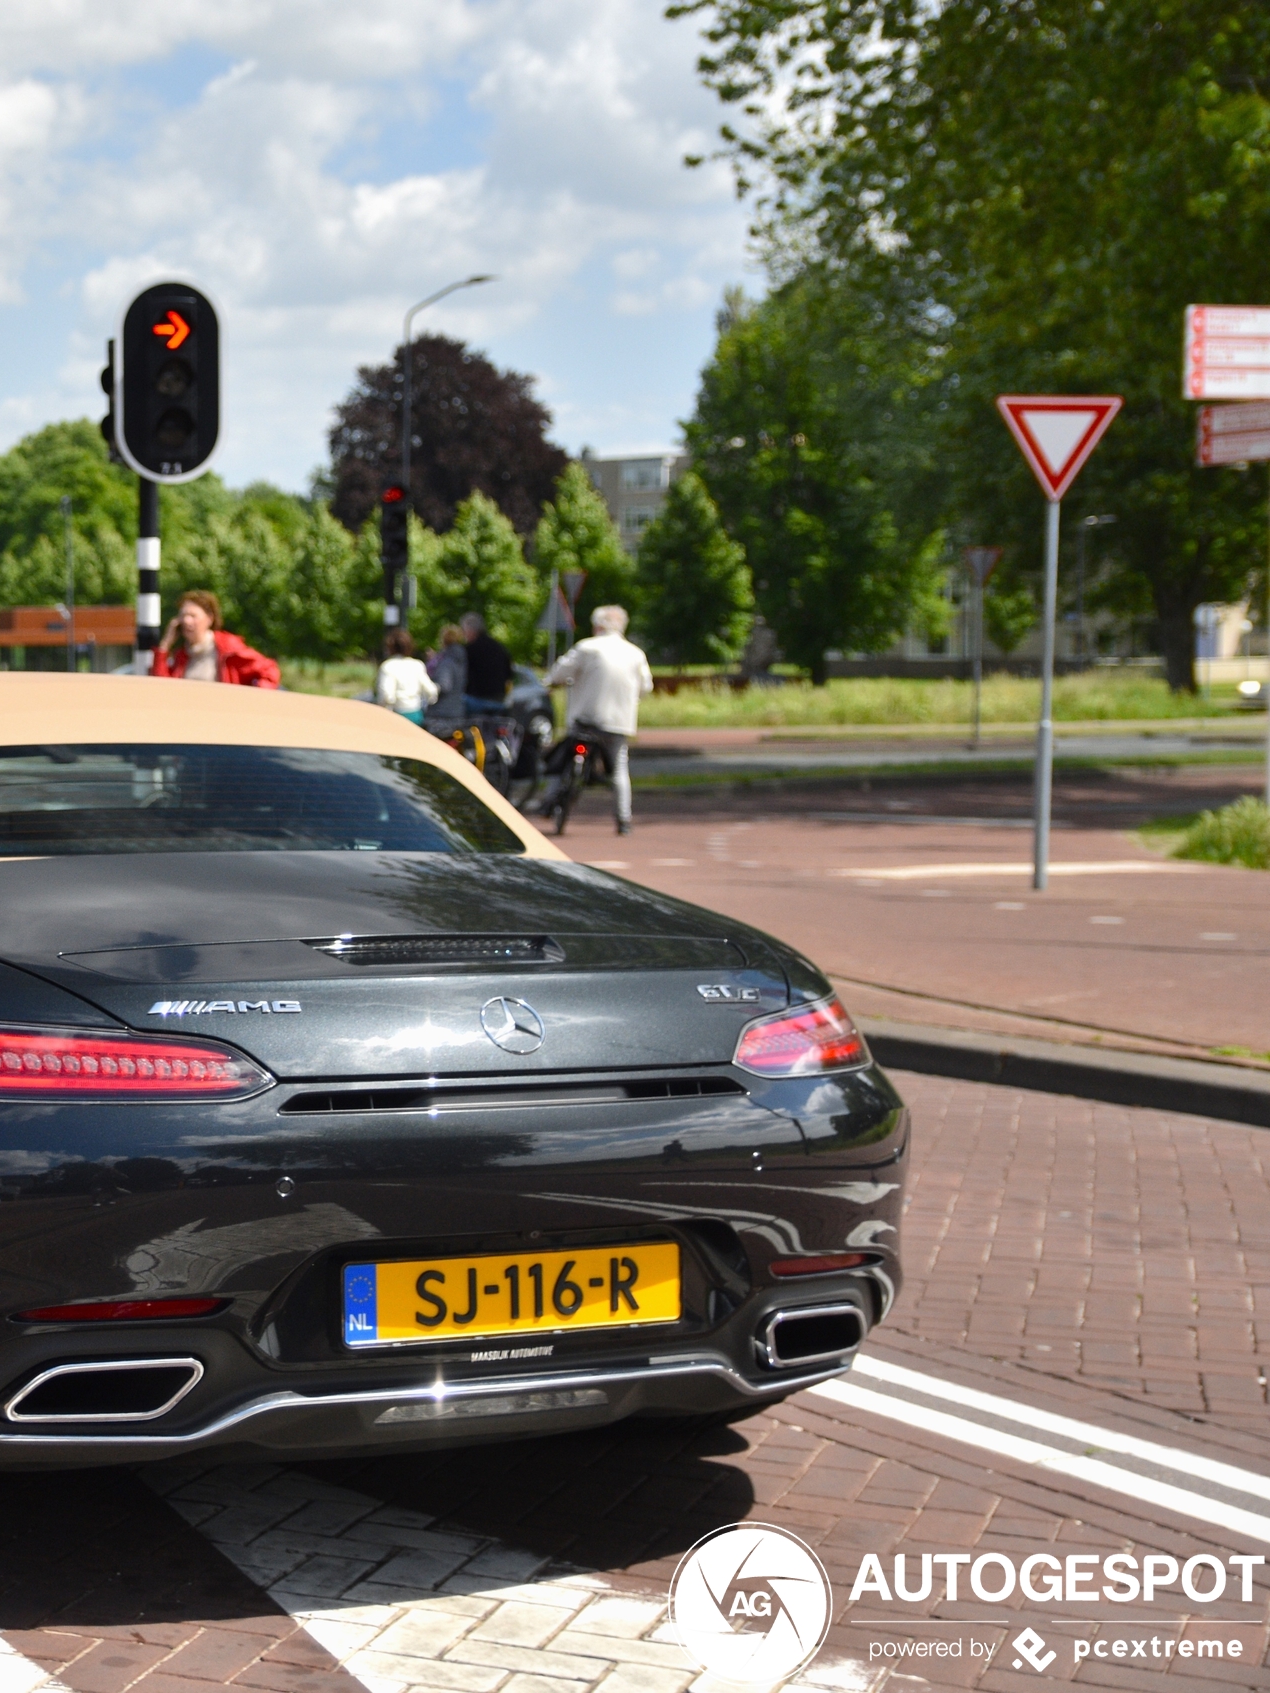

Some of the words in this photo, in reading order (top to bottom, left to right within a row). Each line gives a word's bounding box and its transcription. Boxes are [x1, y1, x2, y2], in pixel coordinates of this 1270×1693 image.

[696, 984, 733, 998] GT
[201, 1000, 302, 1014] AMG
[415, 1256, 640, 1328] SJ-116-R
[349, 1313, 373, 1331] NL
[510, 1345, 554, 1359] AUTOMOTIVE
